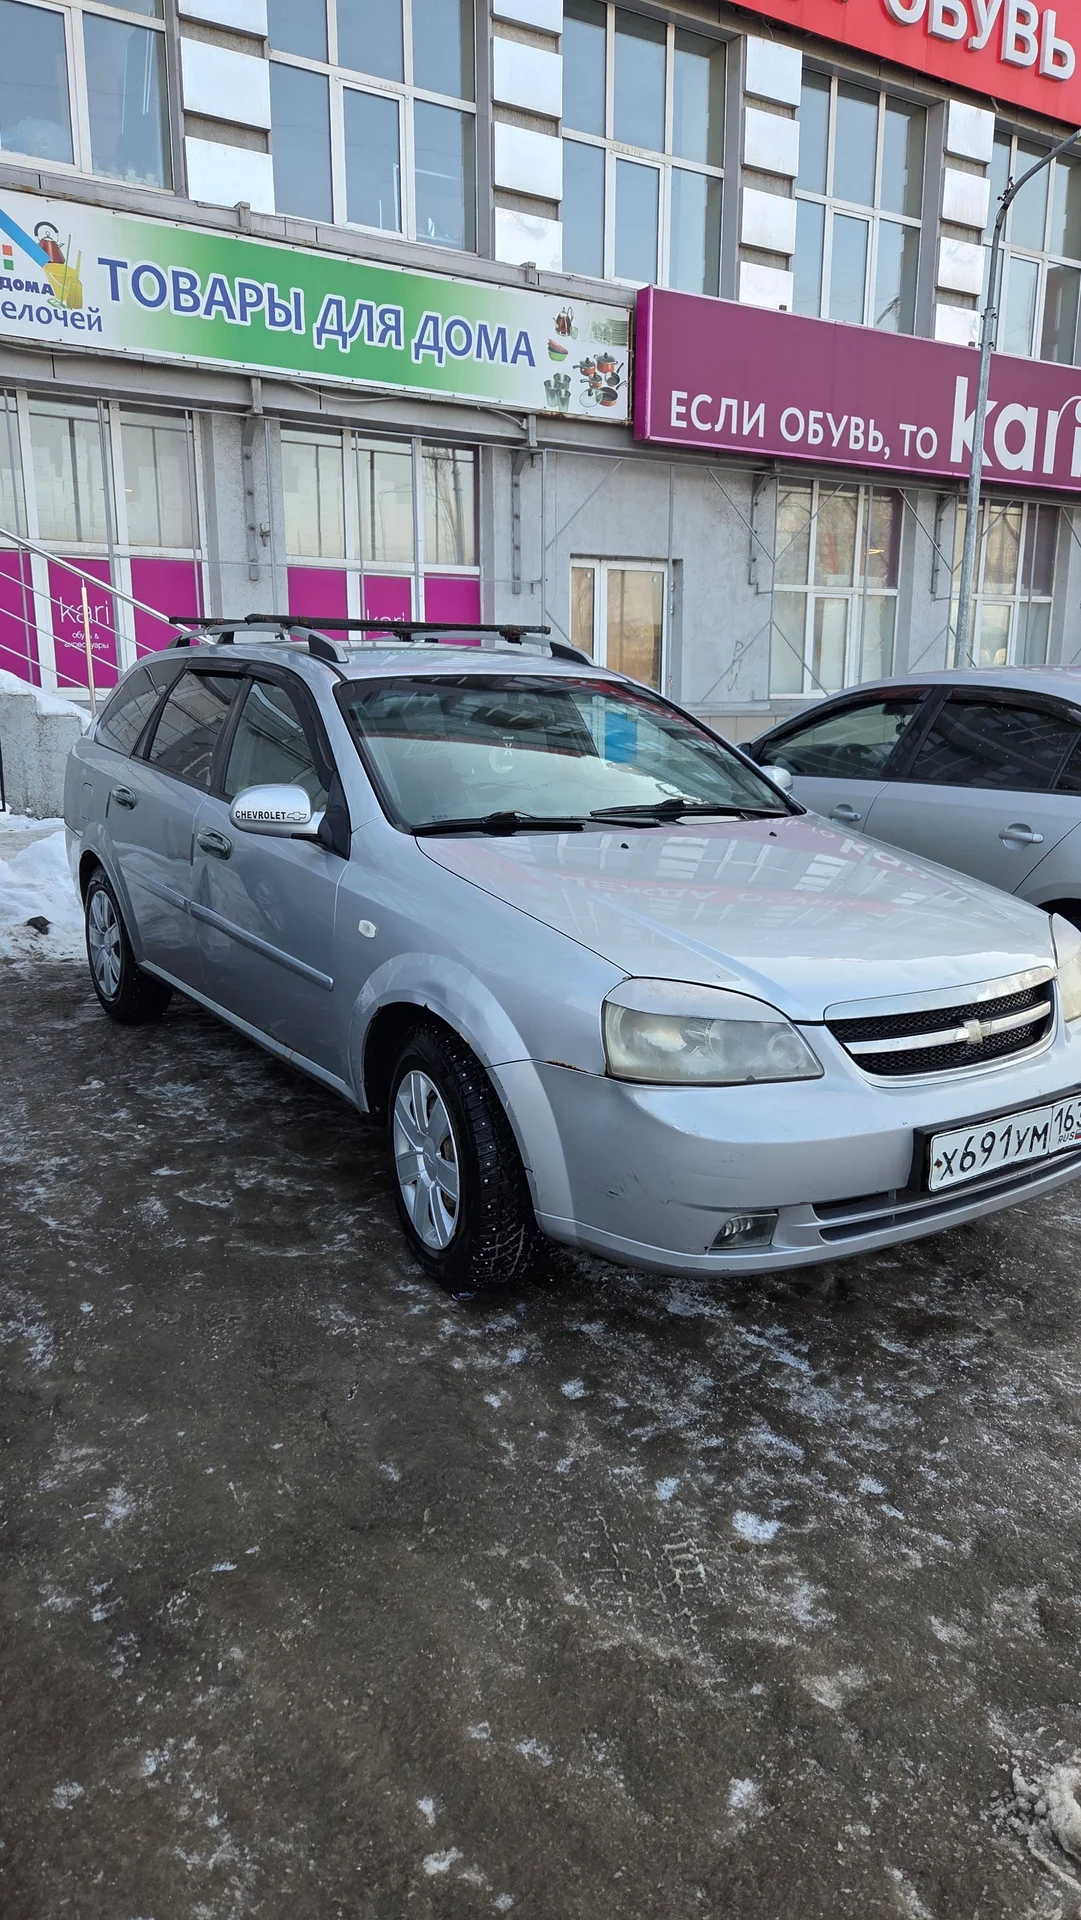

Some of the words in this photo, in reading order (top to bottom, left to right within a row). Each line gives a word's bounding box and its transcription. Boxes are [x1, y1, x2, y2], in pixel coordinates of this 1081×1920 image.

[0, 276, 55, 296] ДОМА
[97, 256, 303, 331] ТОВАРЫ
[316, 297, 402, 350] ДЛЯ
[413, 314, 537, 368] ДОМА
[670, 390, 766, 438] ЕСЛИ
[779, 406, 891, 460] ОБУВЬ,
[898, 423, 938, 460] ТО
[950, 375, 1081, 478] kari
[59, 596, 109, 625] kari
[64, 642, 109, 650] аксесуары
[71, 631, 92, 640] обу
[235, 810, 286, 820] CHEVROLET
[1057, 1131, 1075, 1145] RUS
[939, 1123, 1050, 1181] Х691УМ
